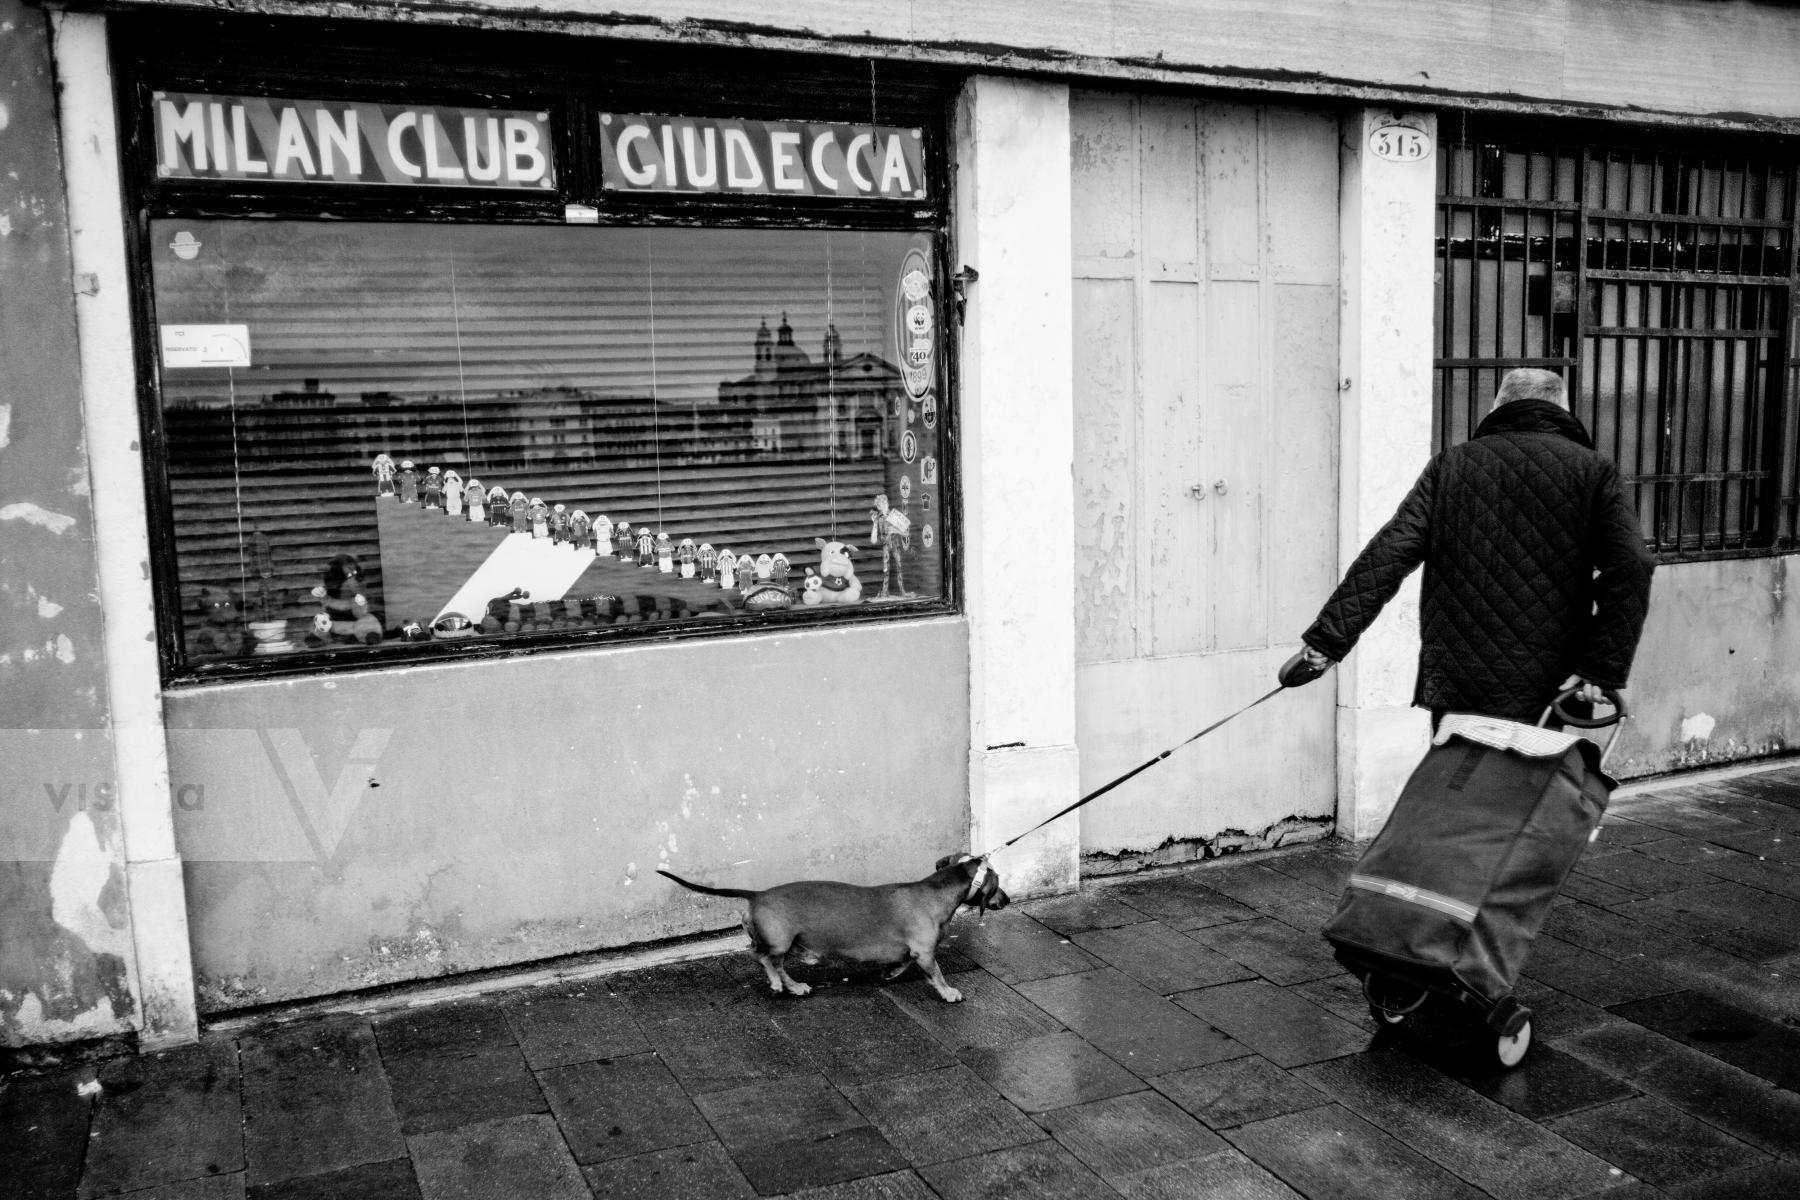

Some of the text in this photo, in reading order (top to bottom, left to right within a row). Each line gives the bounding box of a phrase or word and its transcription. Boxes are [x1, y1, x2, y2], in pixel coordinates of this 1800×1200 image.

[159, 101, 546, 182] MILAN CLUB
[616, 124, 912, 192] GIUDECCA
[1378, 132, 1422, 157] 315
[909, 367, 928, 383] 1899
